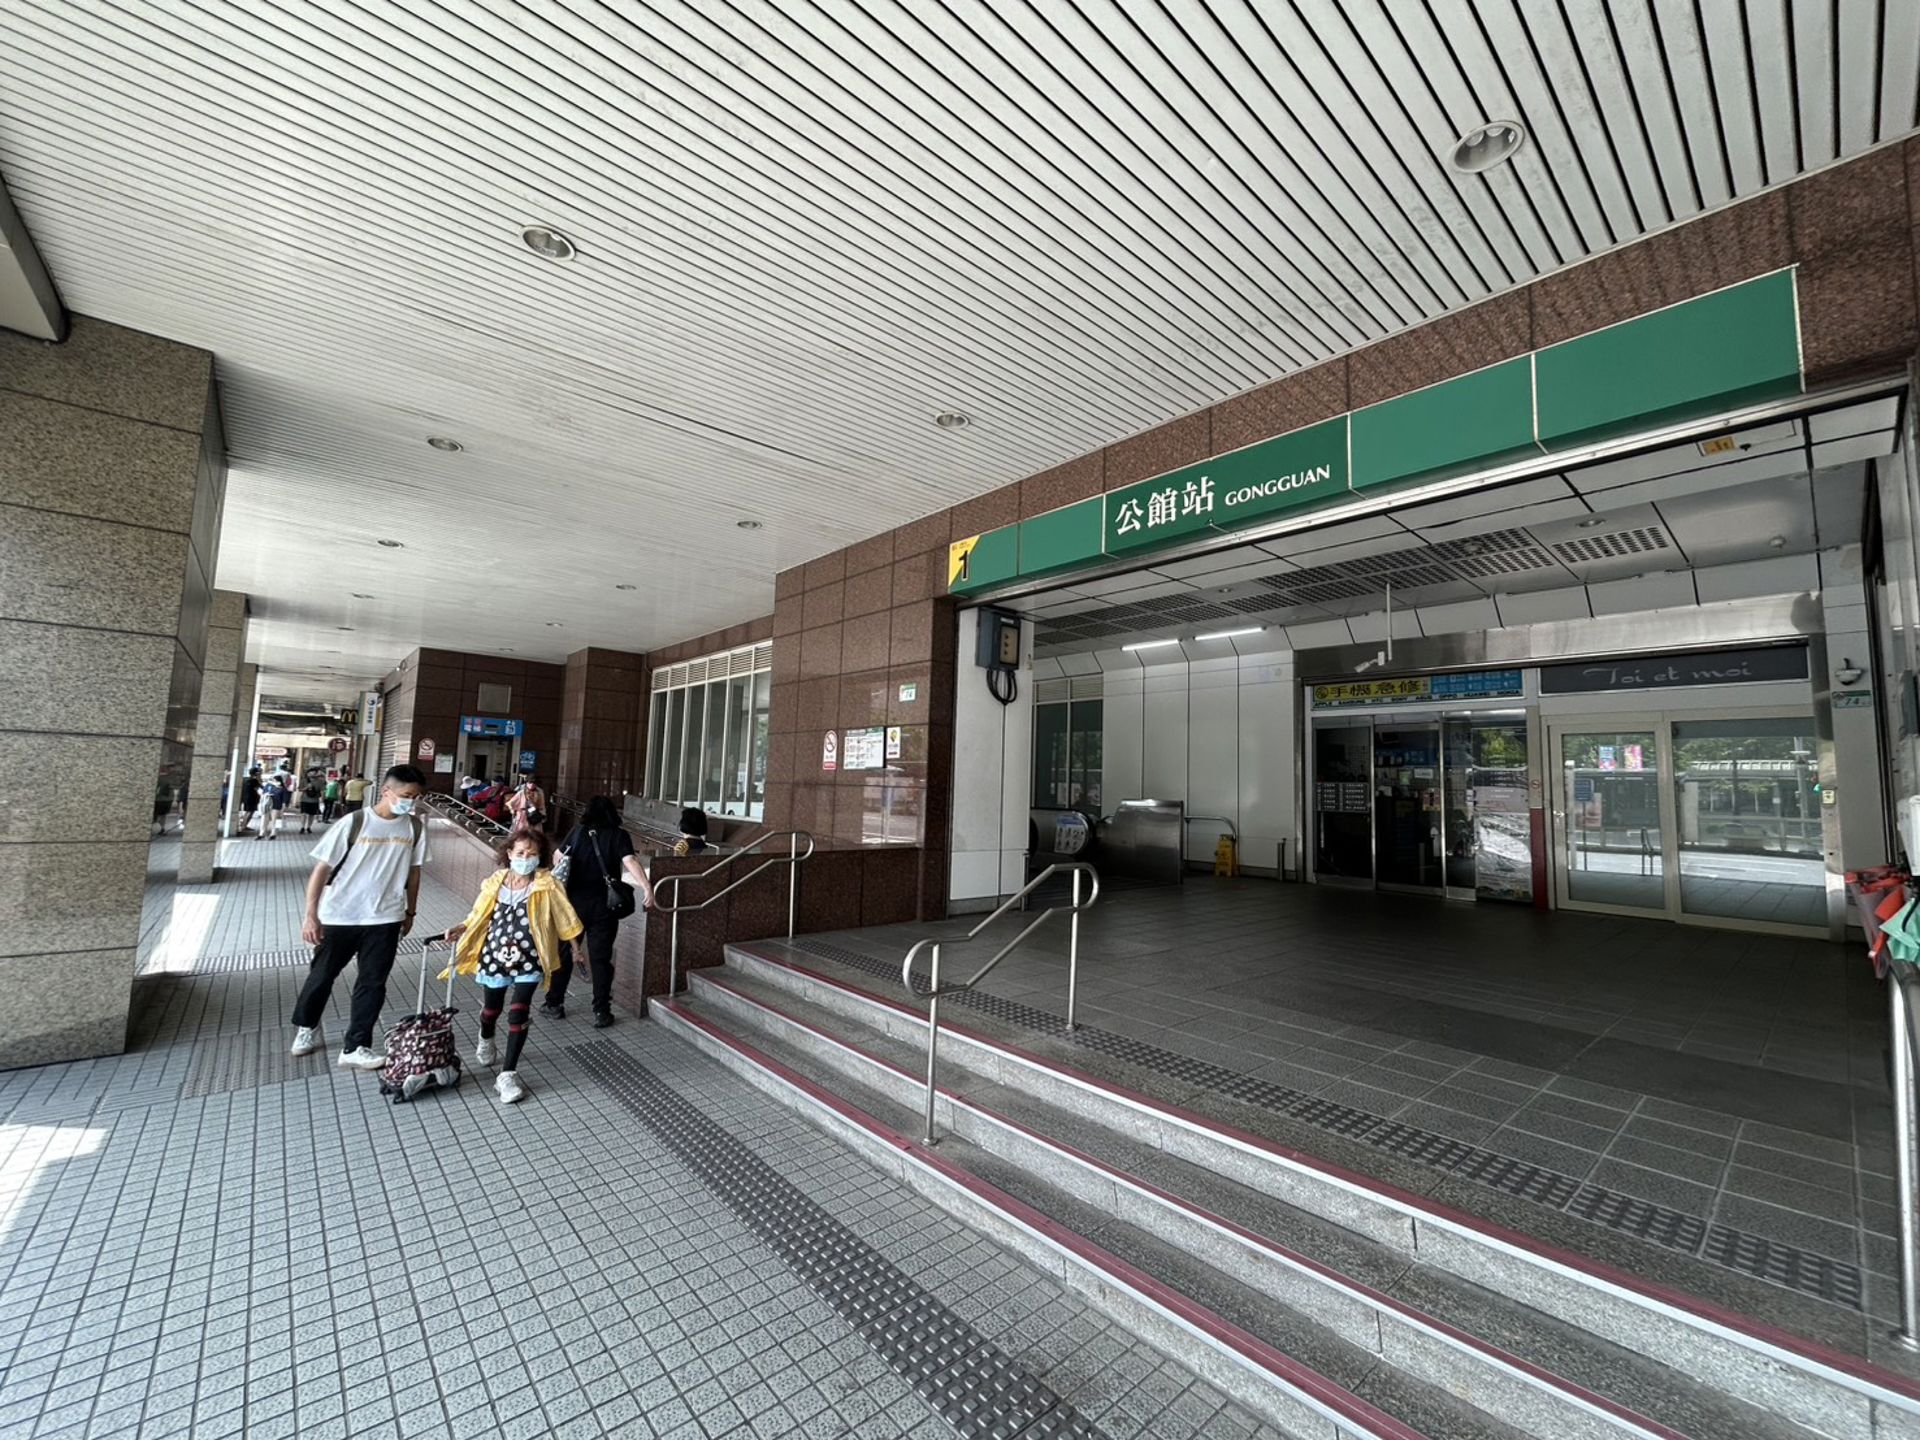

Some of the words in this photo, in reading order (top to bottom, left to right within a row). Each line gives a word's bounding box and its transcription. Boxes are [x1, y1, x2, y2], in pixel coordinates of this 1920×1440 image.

[1225, 463, 1331, 507] GONGGUAN
[1115, 475, 1216, 536] 公館站
[958, 549, 969, 580] 1
[1582, 666, 1645, 685] Toi
[1653, 665, 1680, 681] et
[1692, 661, 1753, 679] moi
[1328, 680, 1422, 698] 手機急修
